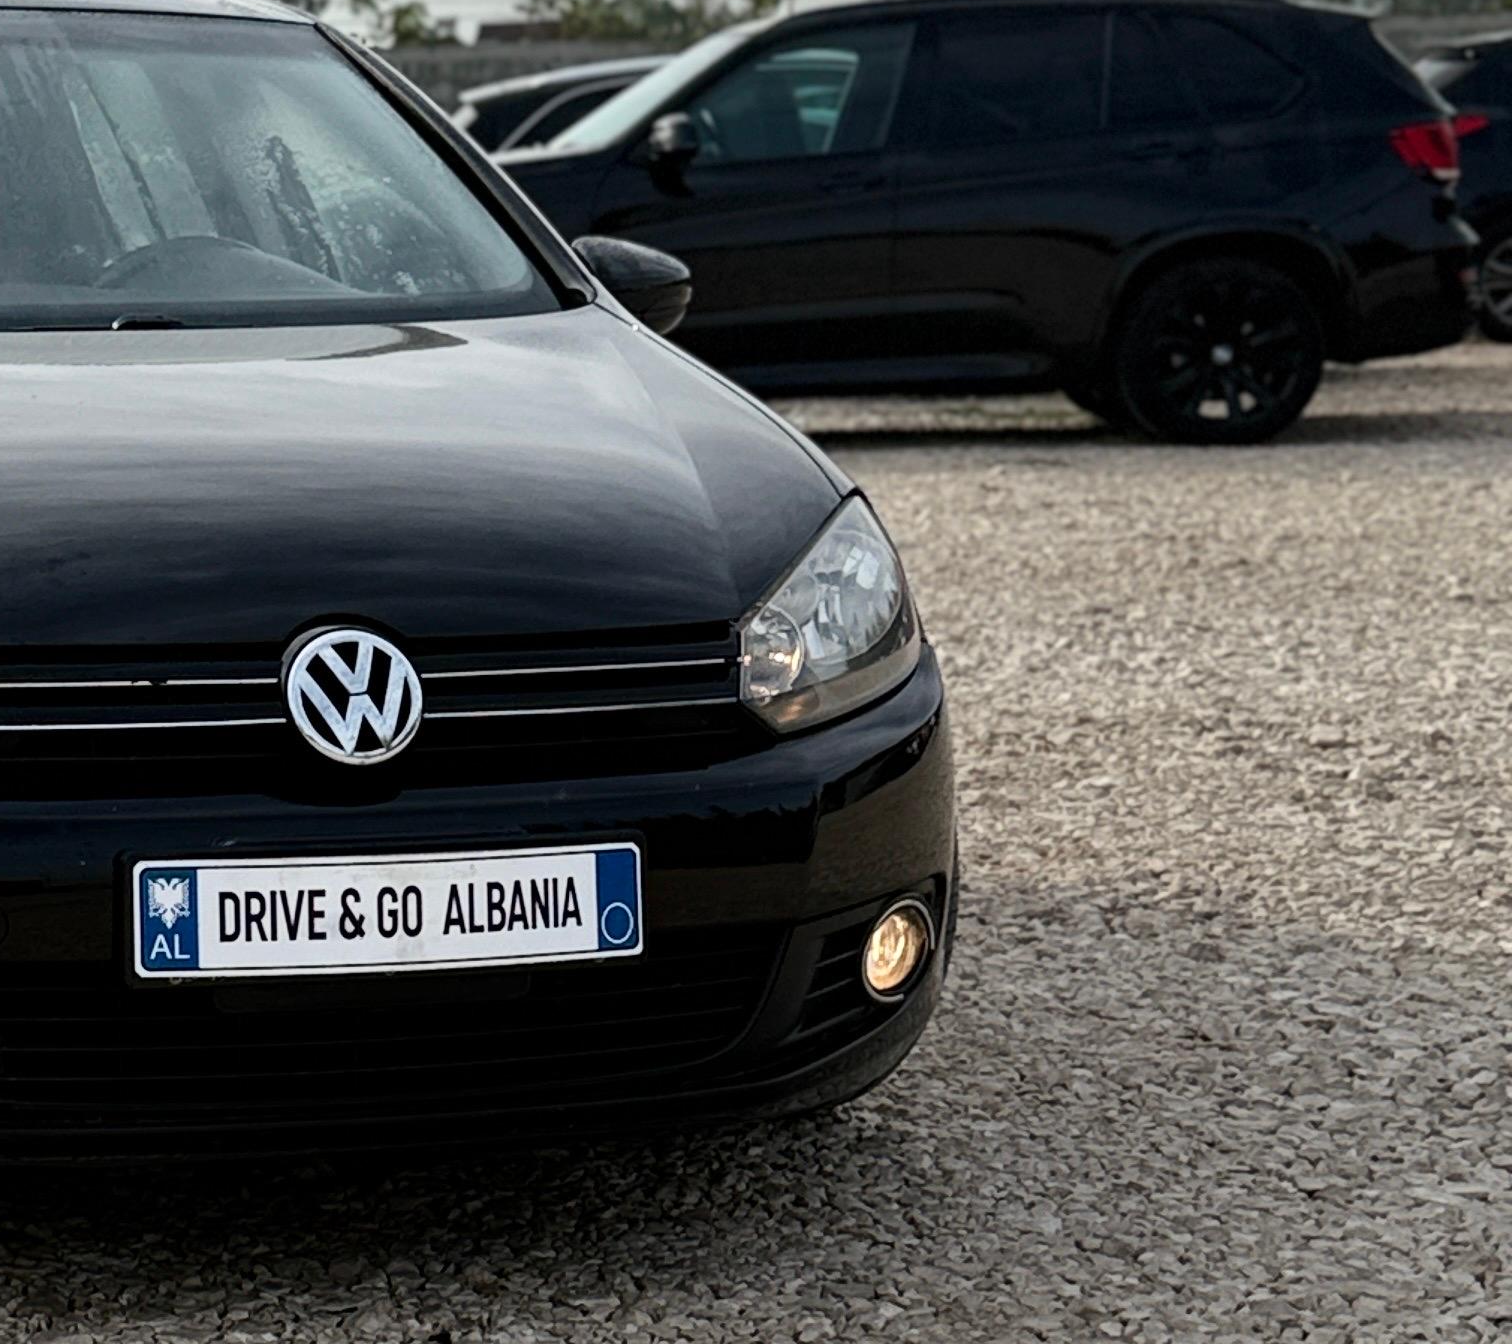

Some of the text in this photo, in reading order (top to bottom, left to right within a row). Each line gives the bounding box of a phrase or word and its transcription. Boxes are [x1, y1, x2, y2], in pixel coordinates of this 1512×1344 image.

[292, 634, 415, 758] VW
[218, 876, 583, 943] DRIVE & GO ALBANIA
[149, 933, 192, 960] AL
